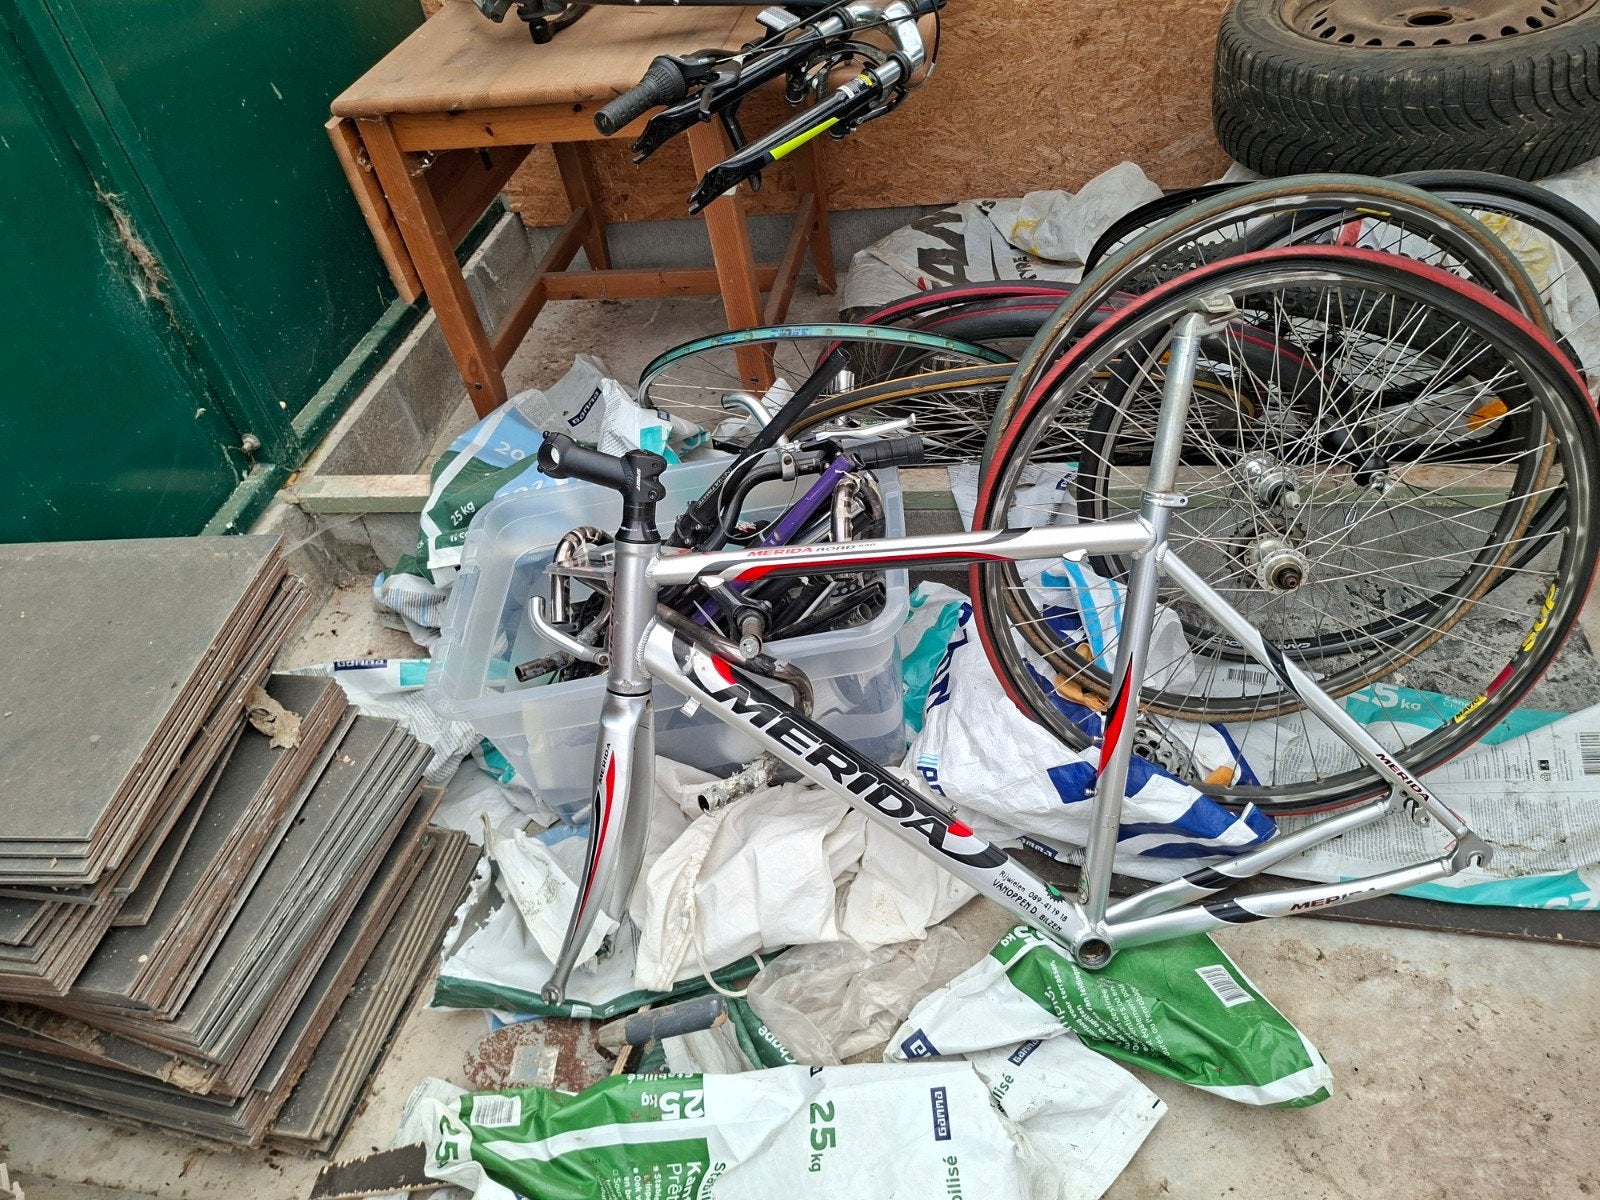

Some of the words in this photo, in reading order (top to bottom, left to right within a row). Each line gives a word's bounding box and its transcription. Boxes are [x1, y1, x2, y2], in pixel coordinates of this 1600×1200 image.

[450, 511, 464, 527] 25
[461, 500, 476, 515] kg
[746, 546, 813, 557] MERIDA
[1401, 700, 1421, 712] kg
[1455, 697, 1480, 720] MAVIC
[599, 742, 612, 785] MERIDA
[708, 684, 948, 852] MERIDA
[1376, 752, 1430, 802] MERIDA
[999, 870, 1026, 893] Rijwielen
[992, 878, 1031, 910] VANOPPEN
[1039, 914, 1062, 932] BILZEN
[1065, 1001, 1077, 1019] voor
[1125, 998, 1149, 1040] également
[641, 1092, 658, 1110] kg
[658, 1089, 705, 1120] 25
[809, 1100, 836, 1151] 25
[808, 1153, 822, 1173] kg
